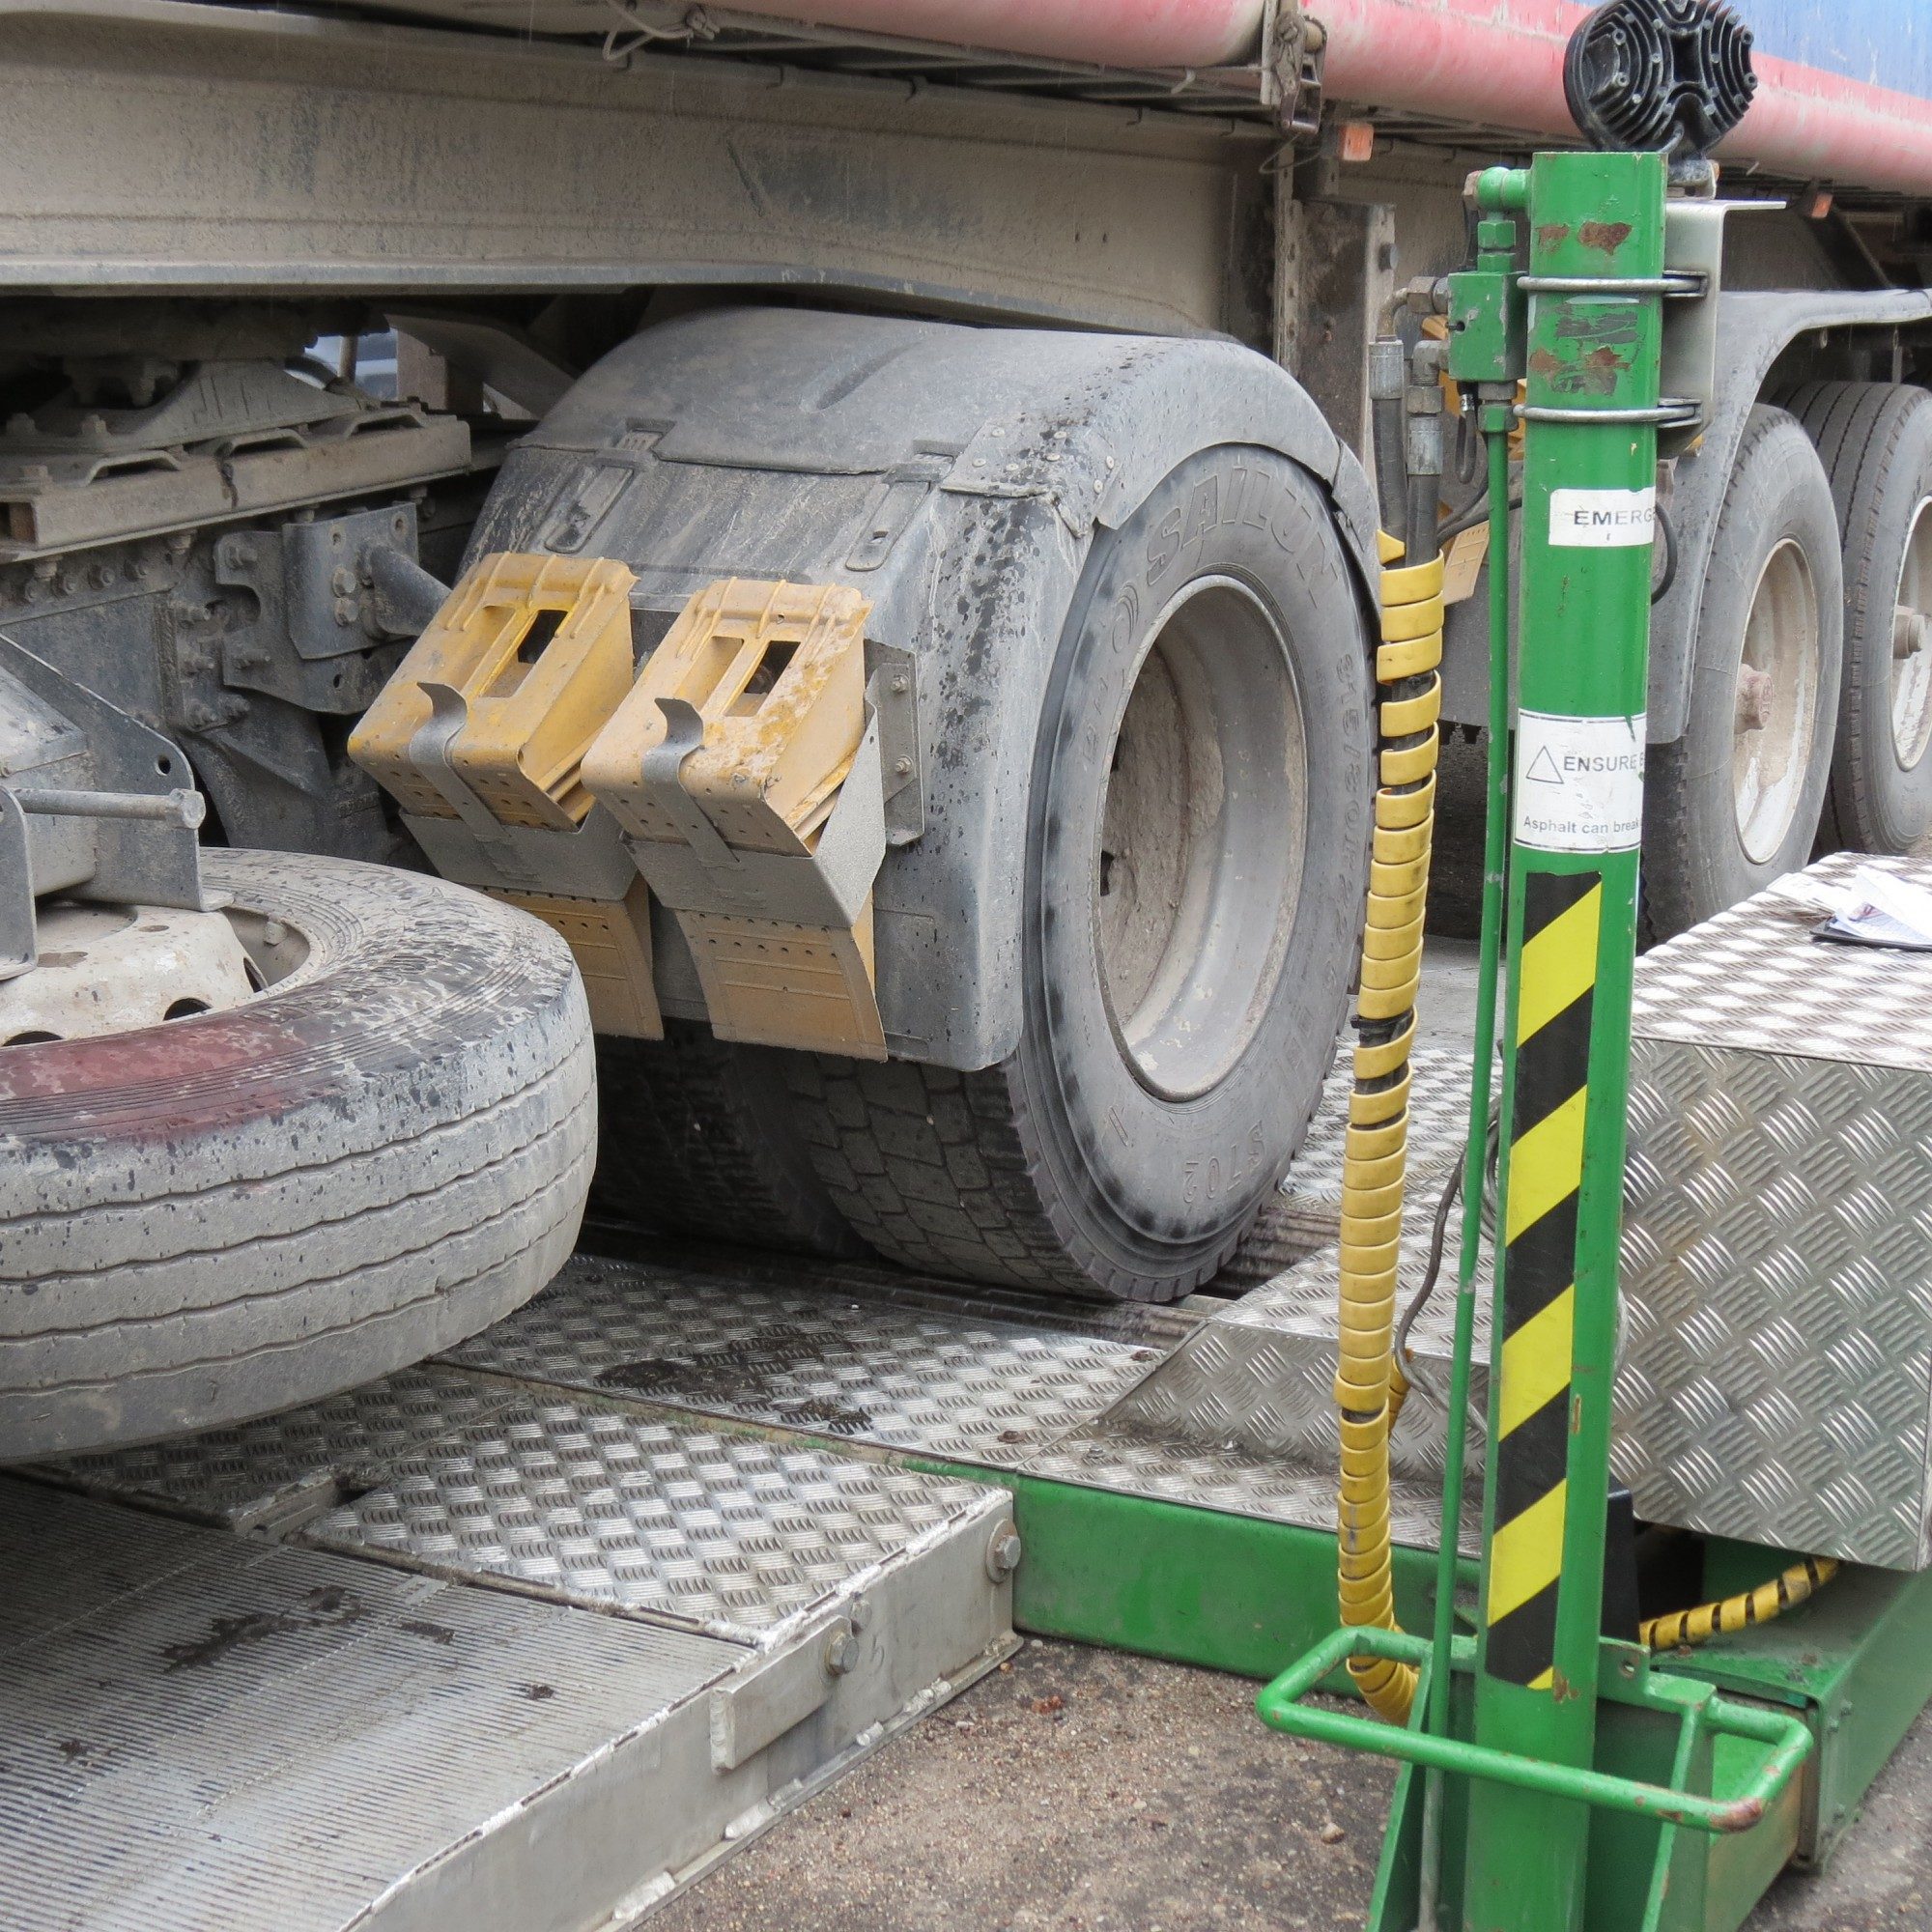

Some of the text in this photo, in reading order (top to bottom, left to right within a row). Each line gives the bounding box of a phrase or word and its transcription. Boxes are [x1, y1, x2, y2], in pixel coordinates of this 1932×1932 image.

[1564, 753, 1638, 772] ENSURE
[1523, 815, 1577, 834] Asphalt
[1581, 822, 1608, 834] can
